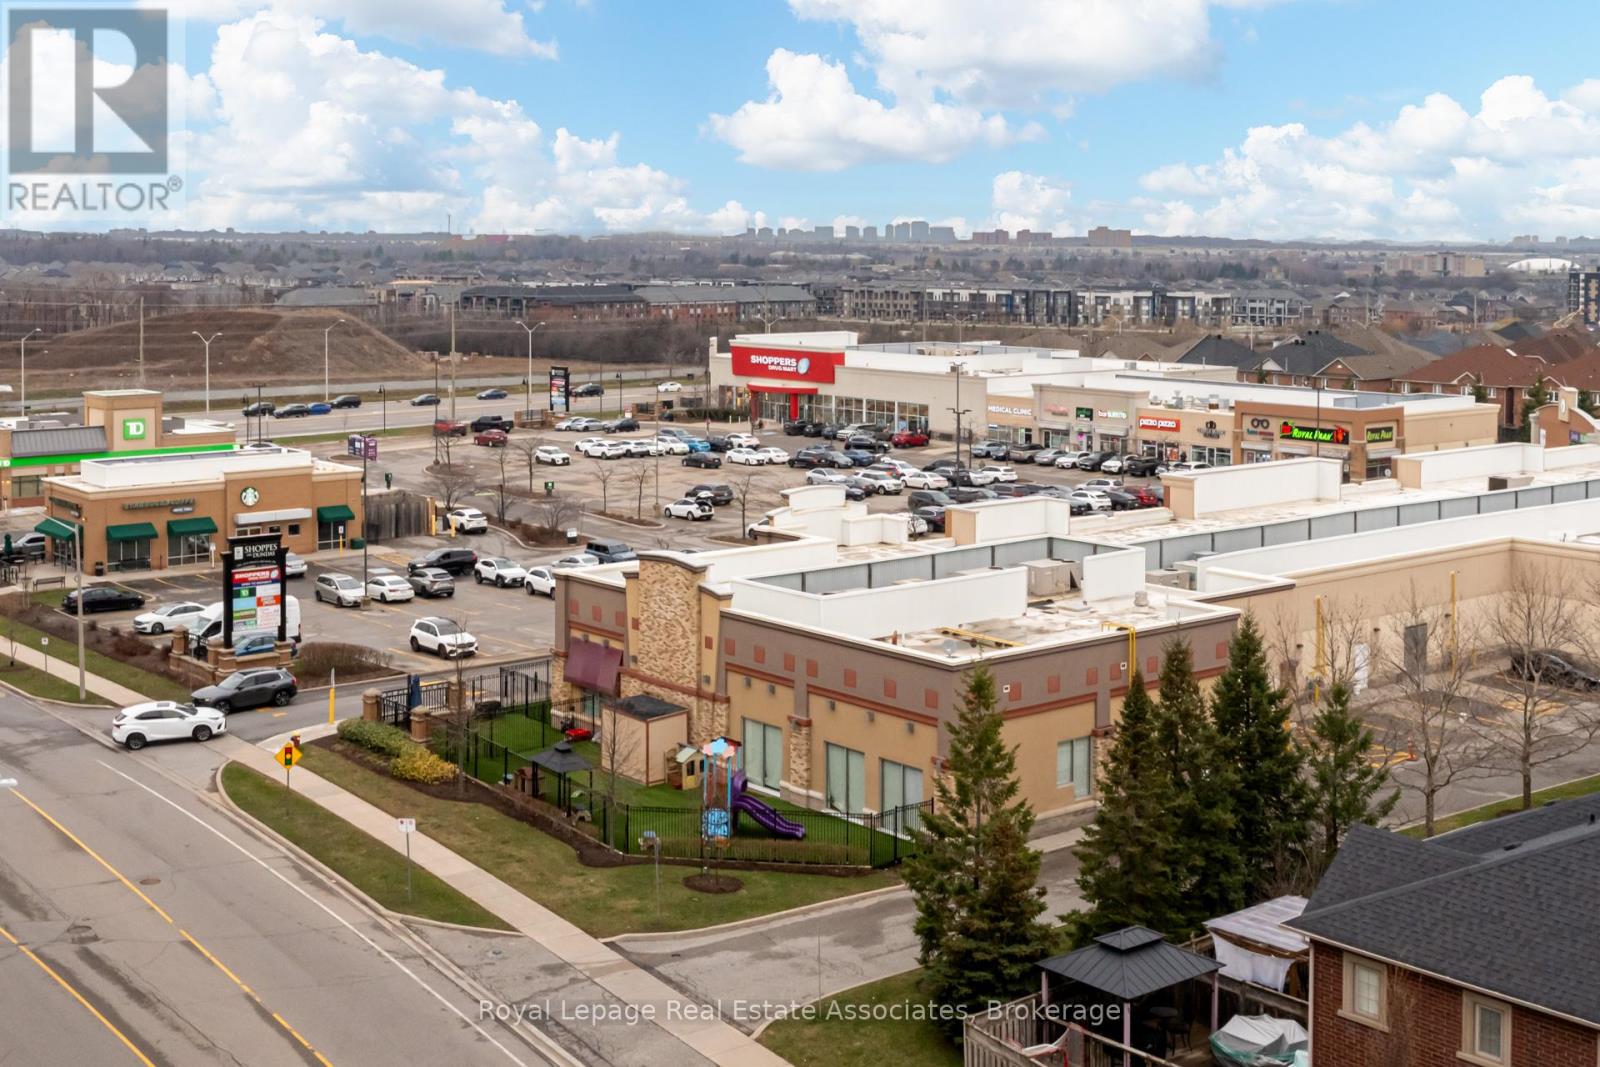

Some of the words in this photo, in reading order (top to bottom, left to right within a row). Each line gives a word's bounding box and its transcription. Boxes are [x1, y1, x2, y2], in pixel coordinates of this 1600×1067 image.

[751, 355, 797, 367] SHOPPERS
[988, 406, 1012, 414] MEDICAL
[1013, 408, 1032, 416] CLINIC
[126, 422, 144, 435] TD
[244, 543, 278, 553] SHOPPES
